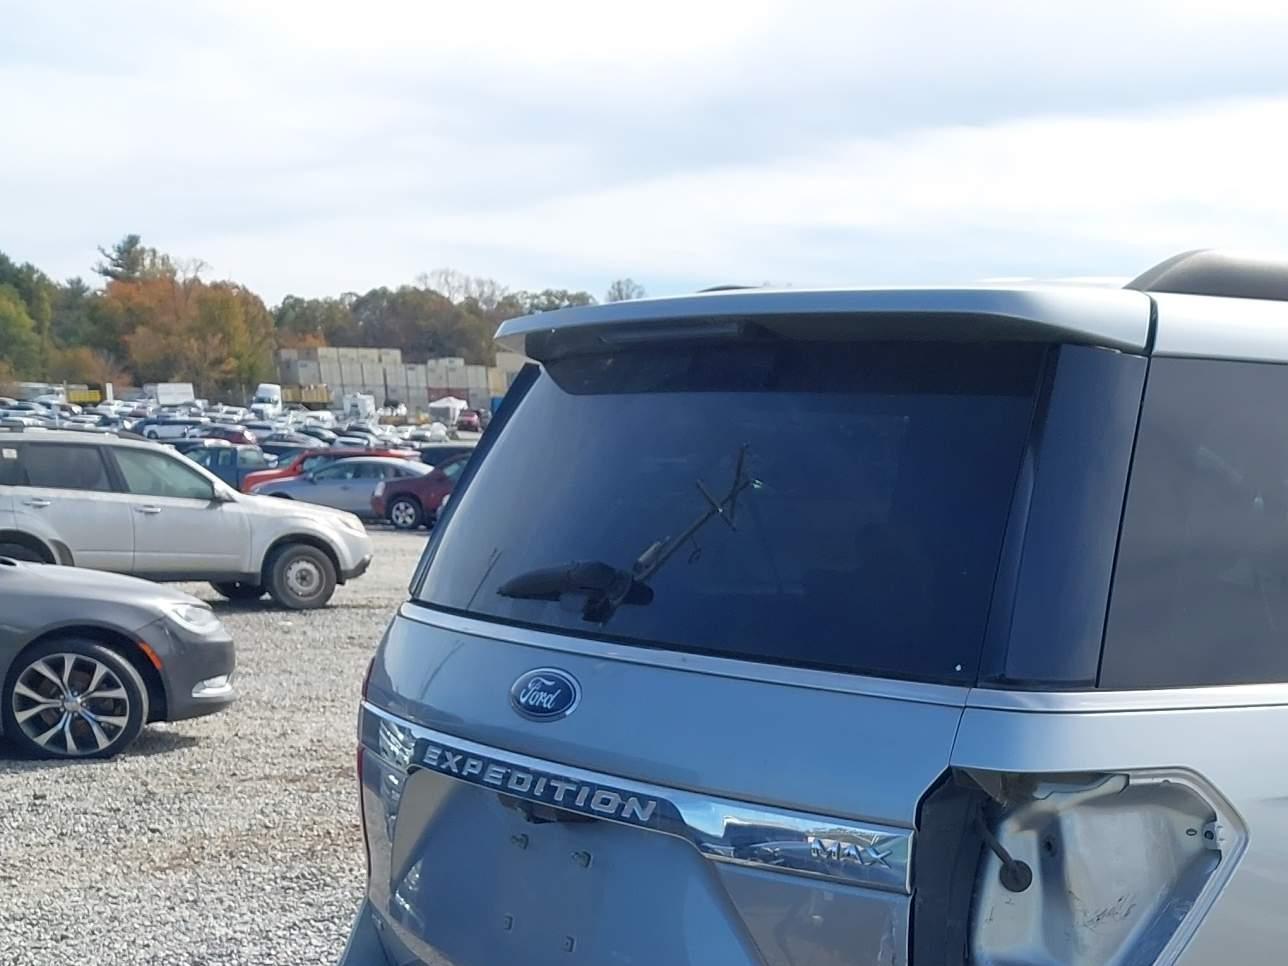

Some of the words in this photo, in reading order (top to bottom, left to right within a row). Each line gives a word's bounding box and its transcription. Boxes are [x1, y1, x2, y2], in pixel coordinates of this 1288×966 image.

[518, 676, 561, 709] Ford
[422, 745, 658, 822] EXPEDITION
[810, 837, 894, 870] MAX
